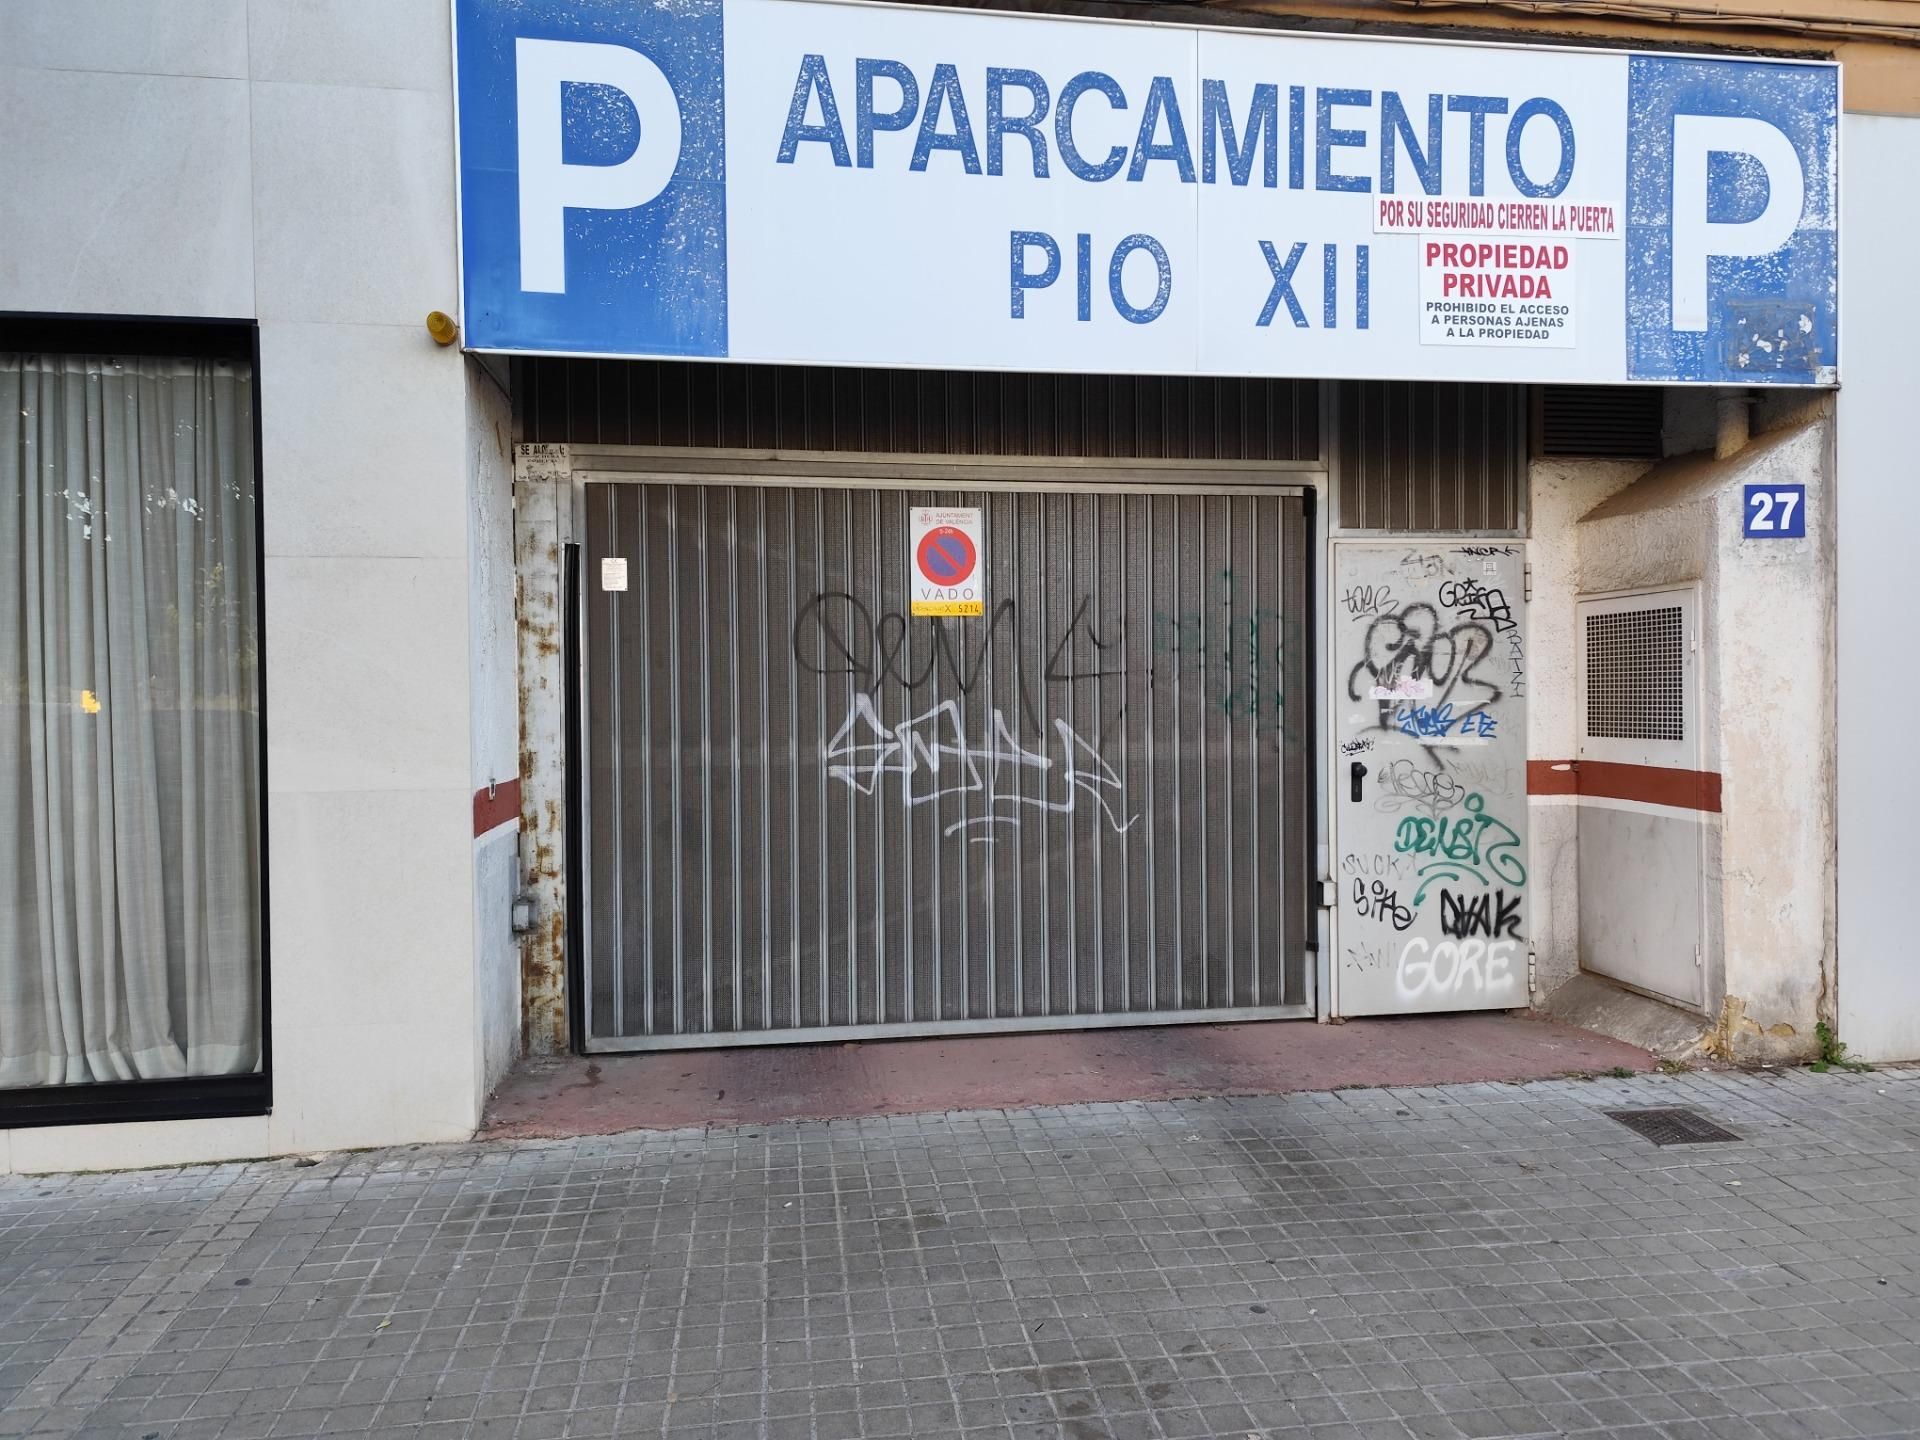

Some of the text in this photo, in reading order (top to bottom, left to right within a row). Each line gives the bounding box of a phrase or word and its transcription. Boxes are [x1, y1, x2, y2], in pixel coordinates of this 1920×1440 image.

[776, 53, 1576, 199] APARCAMIENTO
[515, 37, 683, 294] P
[1380, 200, 1614, 232] POR SU SEGURIDAD CIERREN LA PUERTA
[1671, 113, 1805, 332] P
[1426, 242, 1569, 270] PROPIEDAD
[1010, 230, 1370, 330] PIO XII
[1443, 273, 1552, 299] PRIVADA
[1426, 302, 1569, 316] PROHIBIDO EL ACCESO
[1431, 315, 1564, 328] A PERSONAS AJENAS
[1446, 327, 1549, 340] A LA PROPIEDAD
[1750, 492, 1800, 531] 27
[921, 588, 974, 601] VADO
[958, 604, 979, 613] 5214
[1396, 936, 1517, 998] GORE
